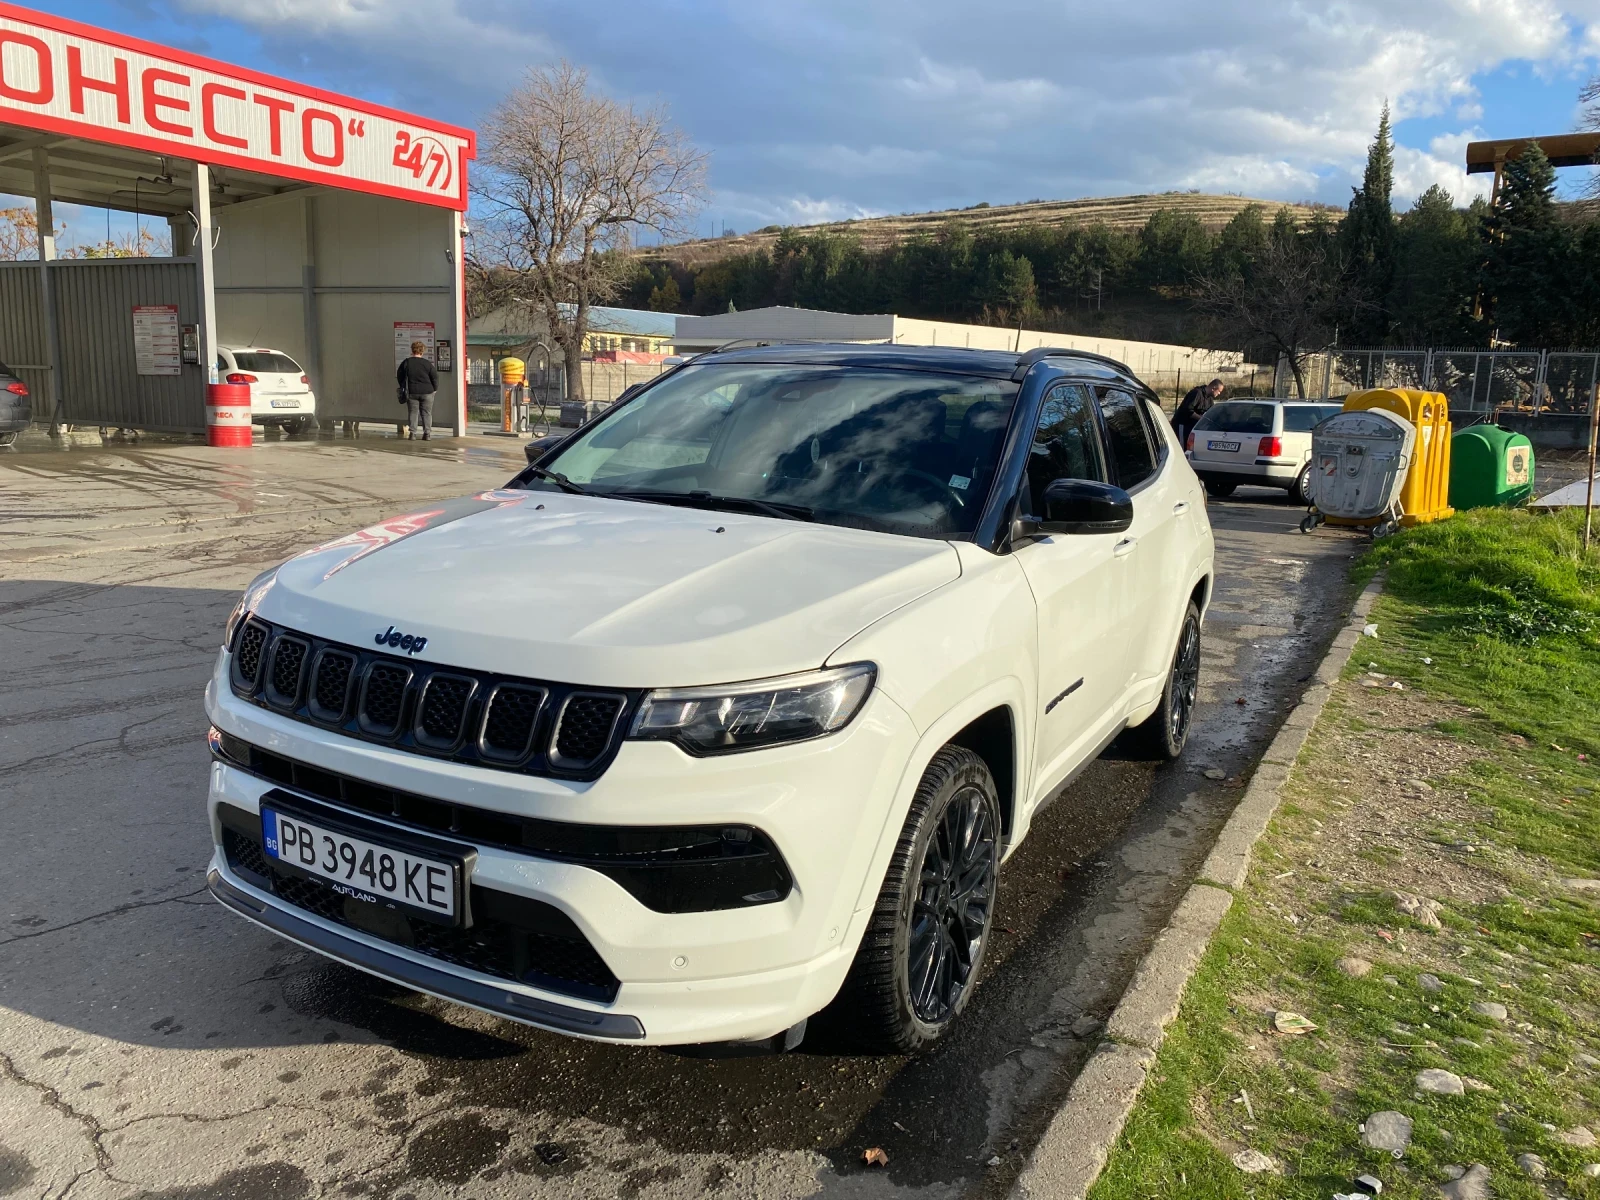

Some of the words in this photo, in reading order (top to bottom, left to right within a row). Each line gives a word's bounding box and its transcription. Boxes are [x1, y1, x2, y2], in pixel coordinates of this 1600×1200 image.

[392, 130, 445, 188] 24/7
[374, 625, 428, 656] Jeep
[266, 837, 278, 850] BG
[280, 819, 316, 866] PB
[322, 835, 397, 892] 3948
[404, 859, 448, 909] KE
[331, 883, 377, 903] AUTOLAND
